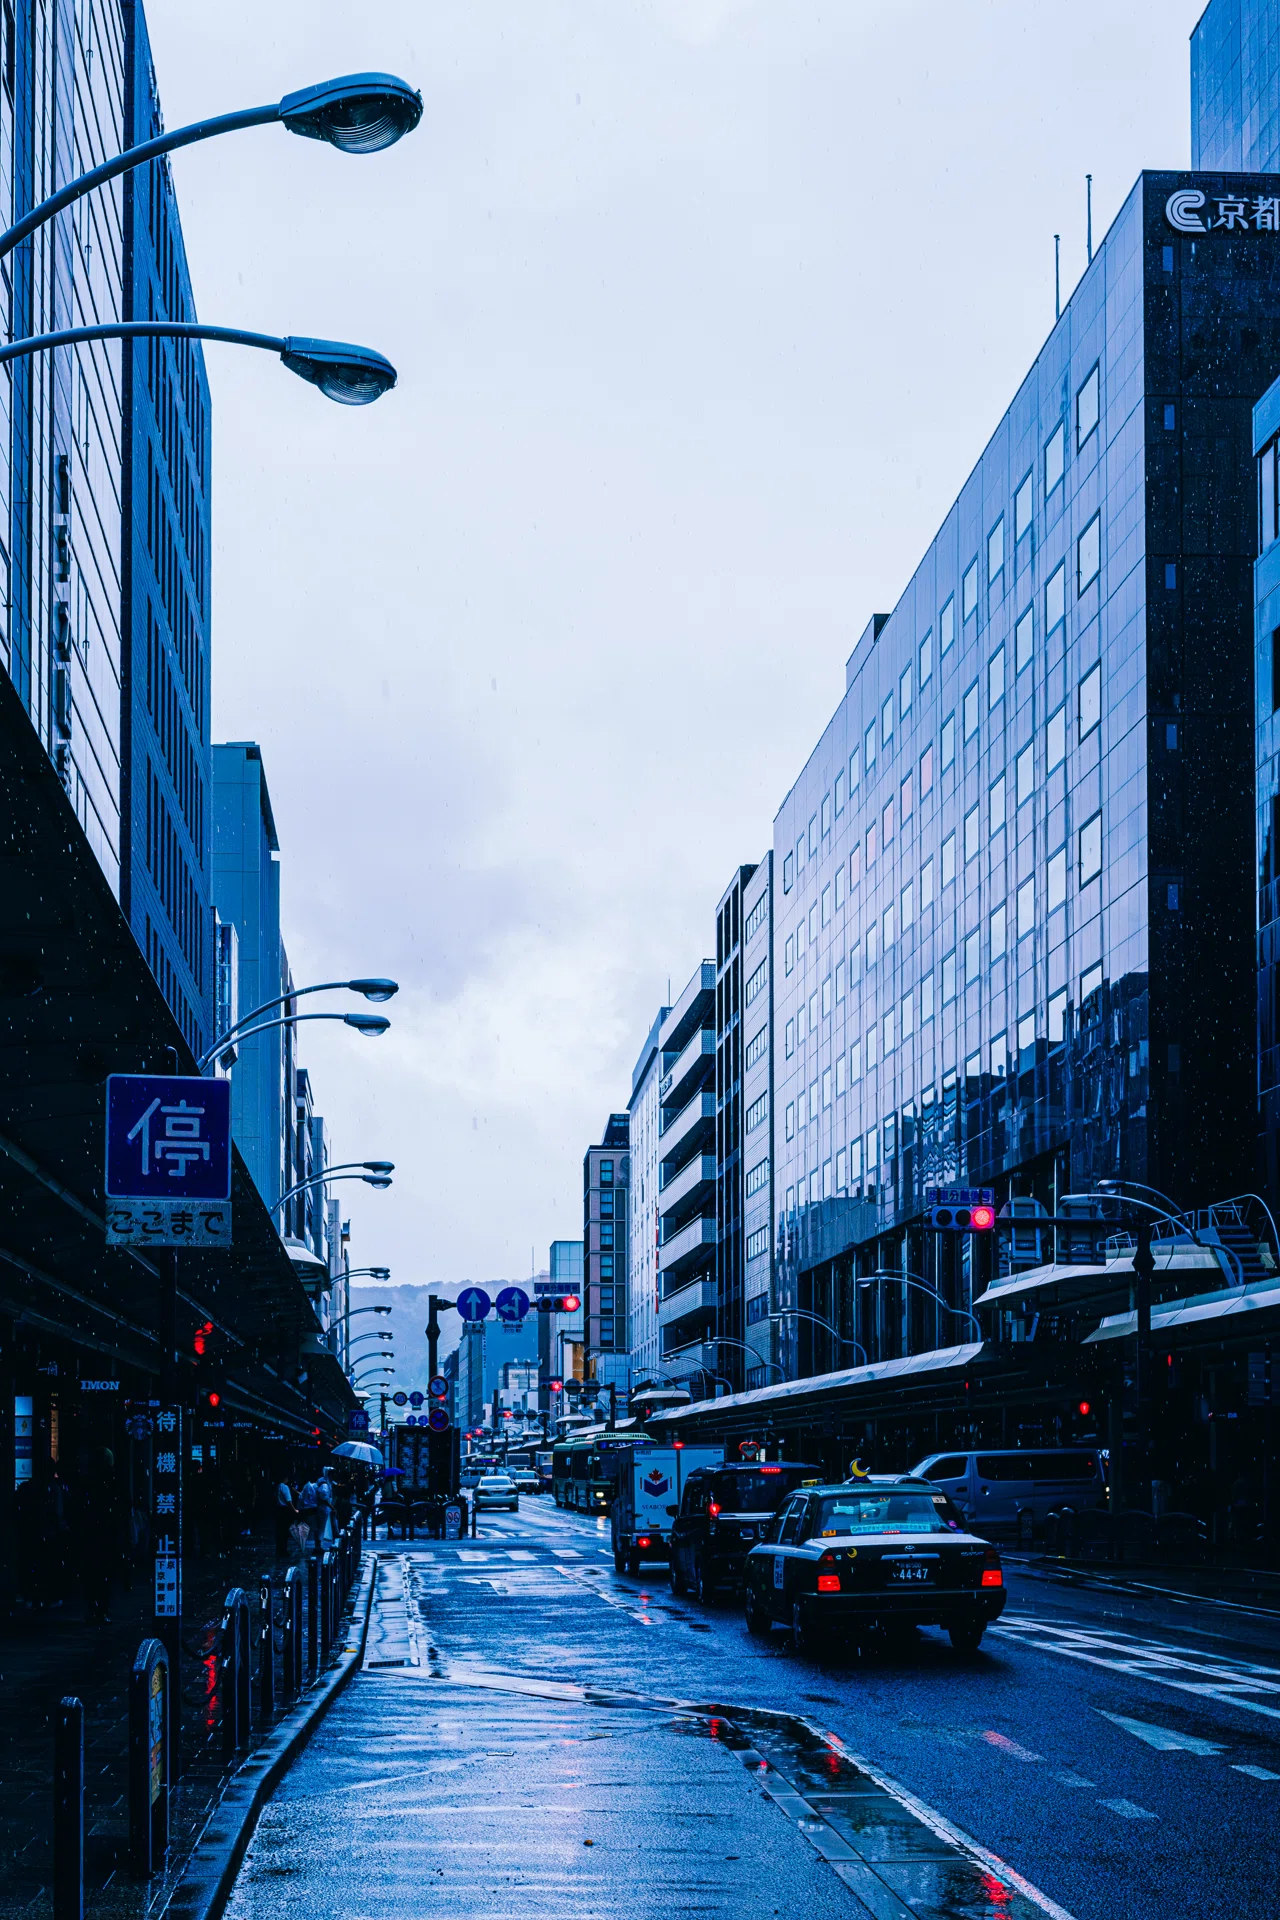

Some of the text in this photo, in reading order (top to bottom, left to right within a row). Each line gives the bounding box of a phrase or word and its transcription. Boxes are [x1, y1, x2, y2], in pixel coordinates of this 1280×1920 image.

[1211, 193, 1280, 231] 京都
[127, 1097, 210, 1177] 停
[111, 1209, 225, 1236] ここまで
[80, 1380, 121, 1391] IMON
[156, 1411, 177, 1556] 待機禁止
[166, 1560, 175, 1613] 京都市
[899, 1568, 929, 1580] 44-47
